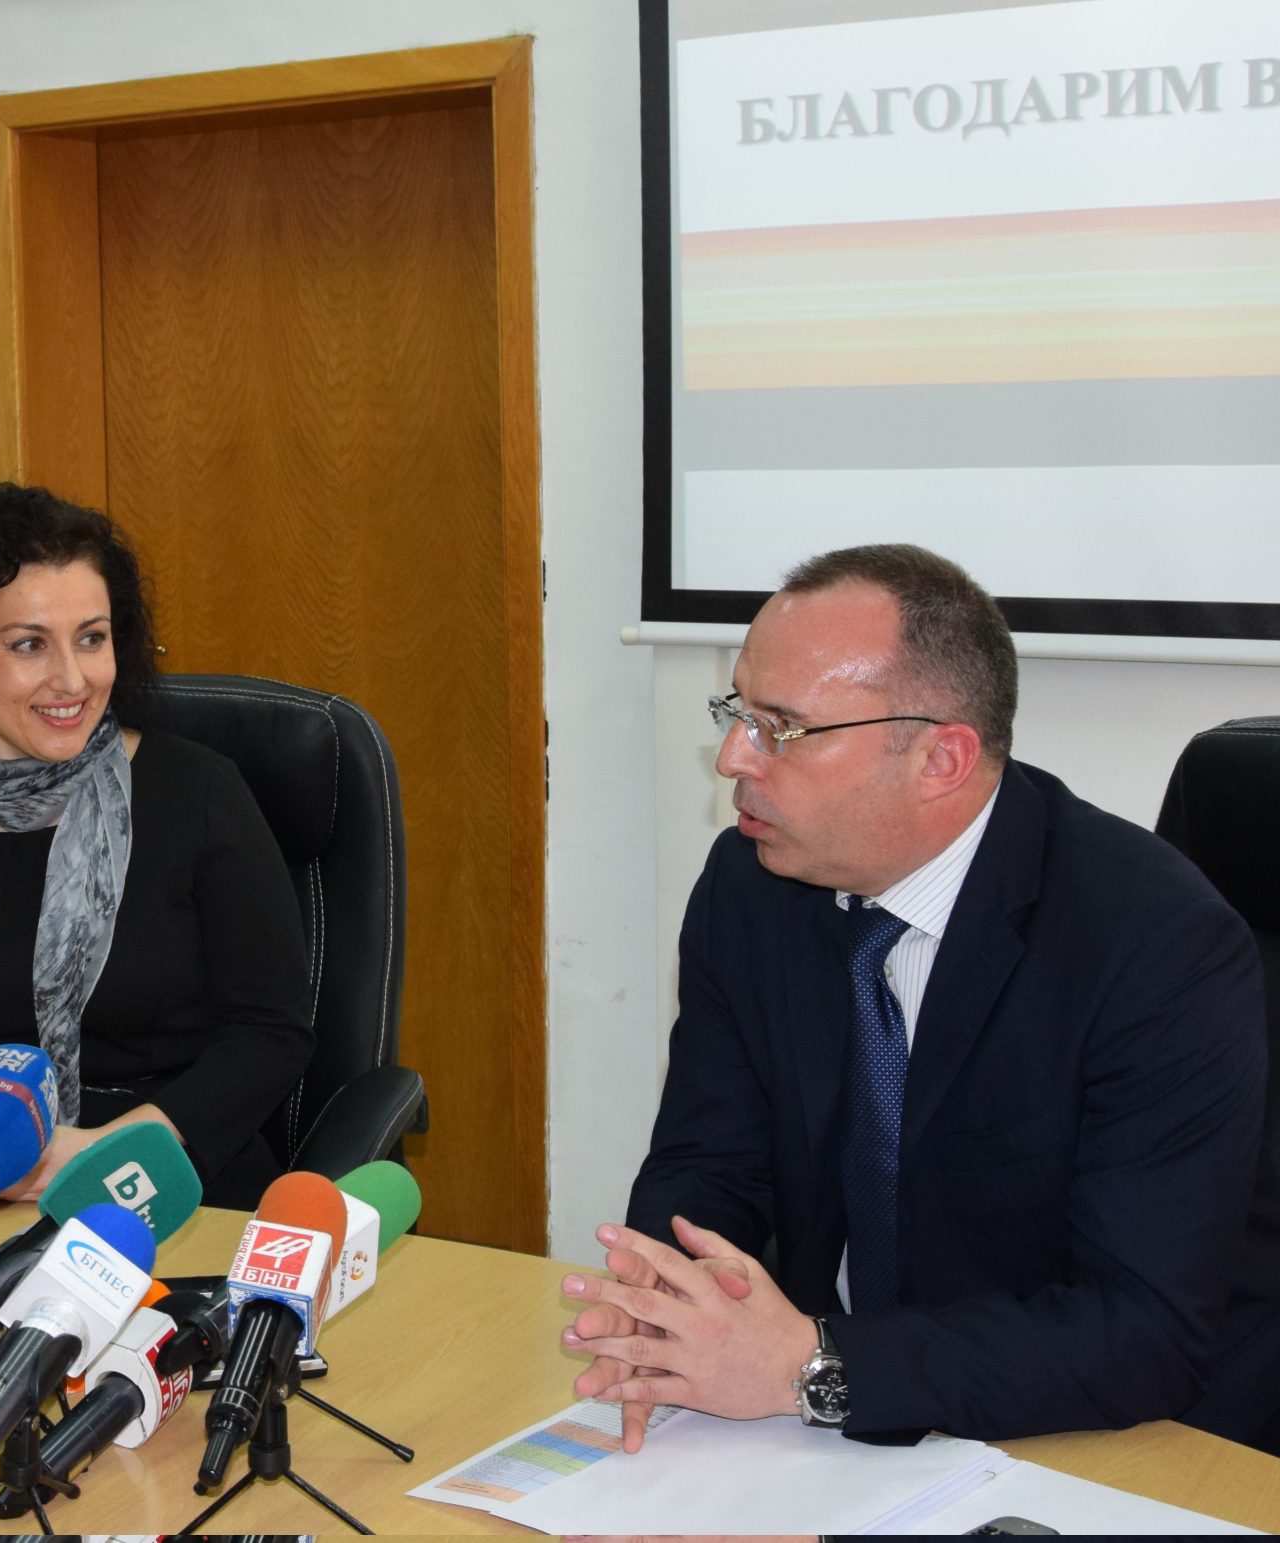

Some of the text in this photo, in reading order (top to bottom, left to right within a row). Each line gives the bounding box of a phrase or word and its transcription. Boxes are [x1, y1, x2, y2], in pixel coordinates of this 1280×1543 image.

[736, 62, 1223, 146] БЛАГОДАРИМ
[79, 1252, 135, 1299] БГНЕС
[230, 1223, 259, 1279] www.bnt.bg
[244, 1267, 298, 1289] БНТ
